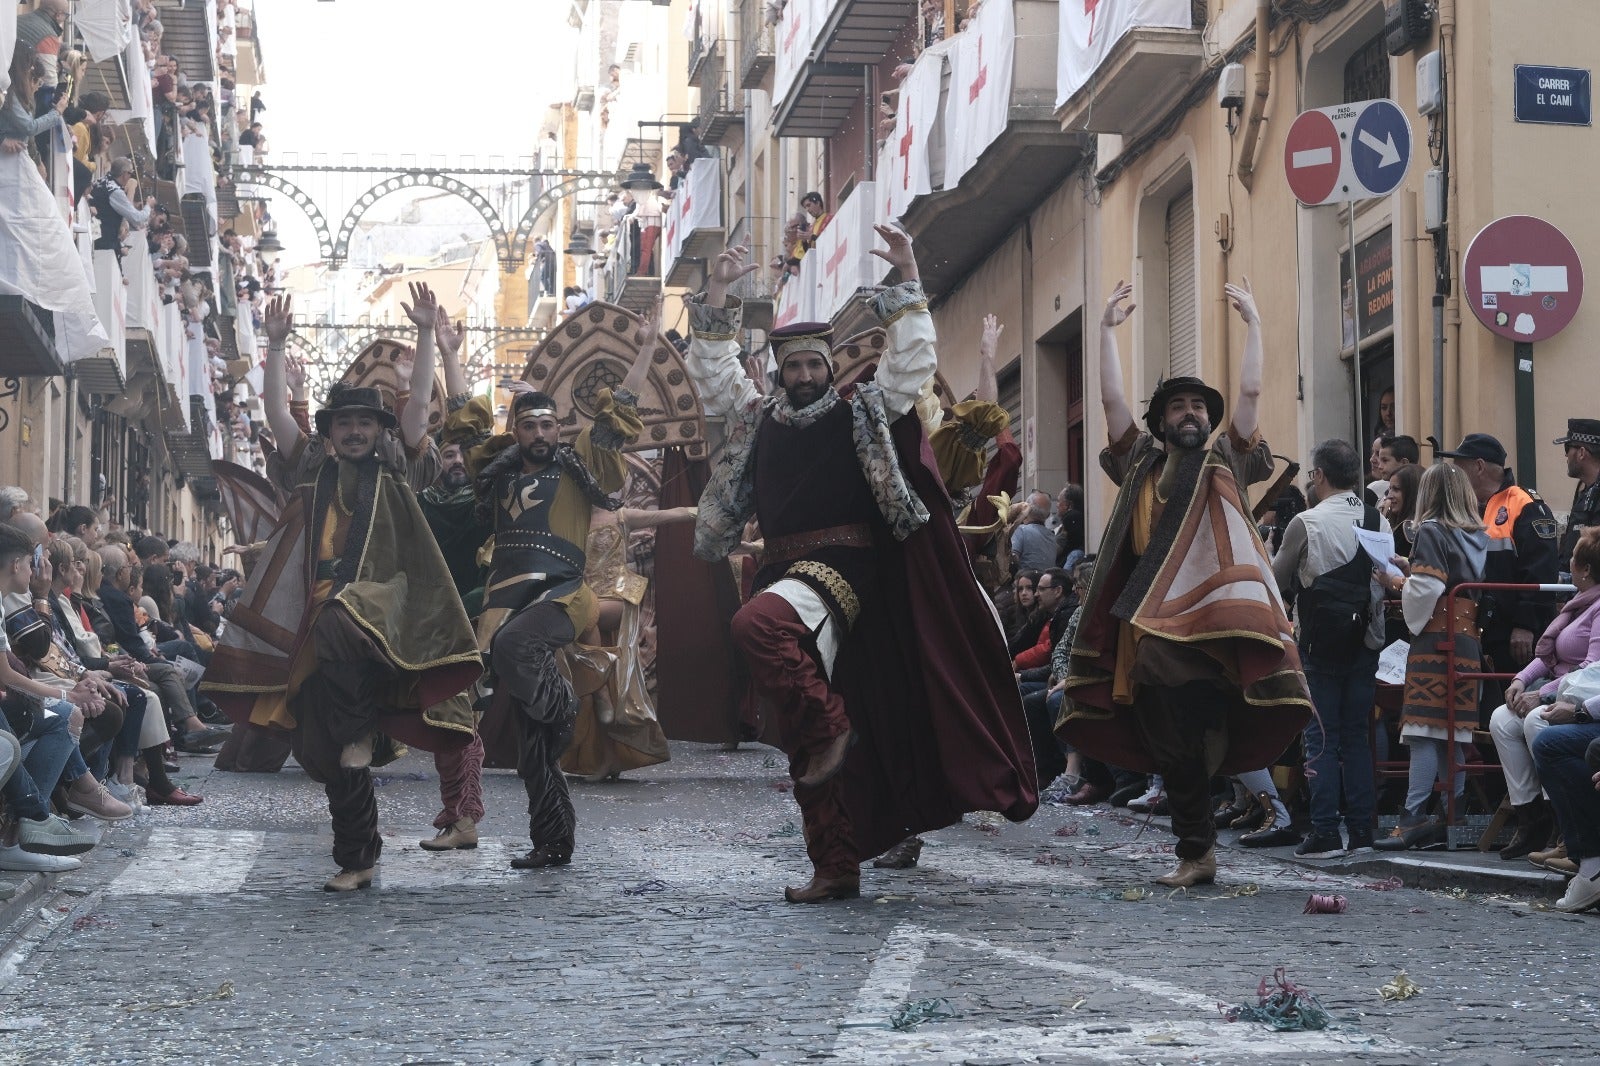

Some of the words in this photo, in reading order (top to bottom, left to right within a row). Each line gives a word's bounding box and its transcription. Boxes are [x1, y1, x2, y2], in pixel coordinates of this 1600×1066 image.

[1538, 77, 1570, 90] CARRER
[1536, 93, 1546, 105] EL
[1550, 93, 1572, 107] CAMÍ
[1367, 277, 1375, 294] LA
